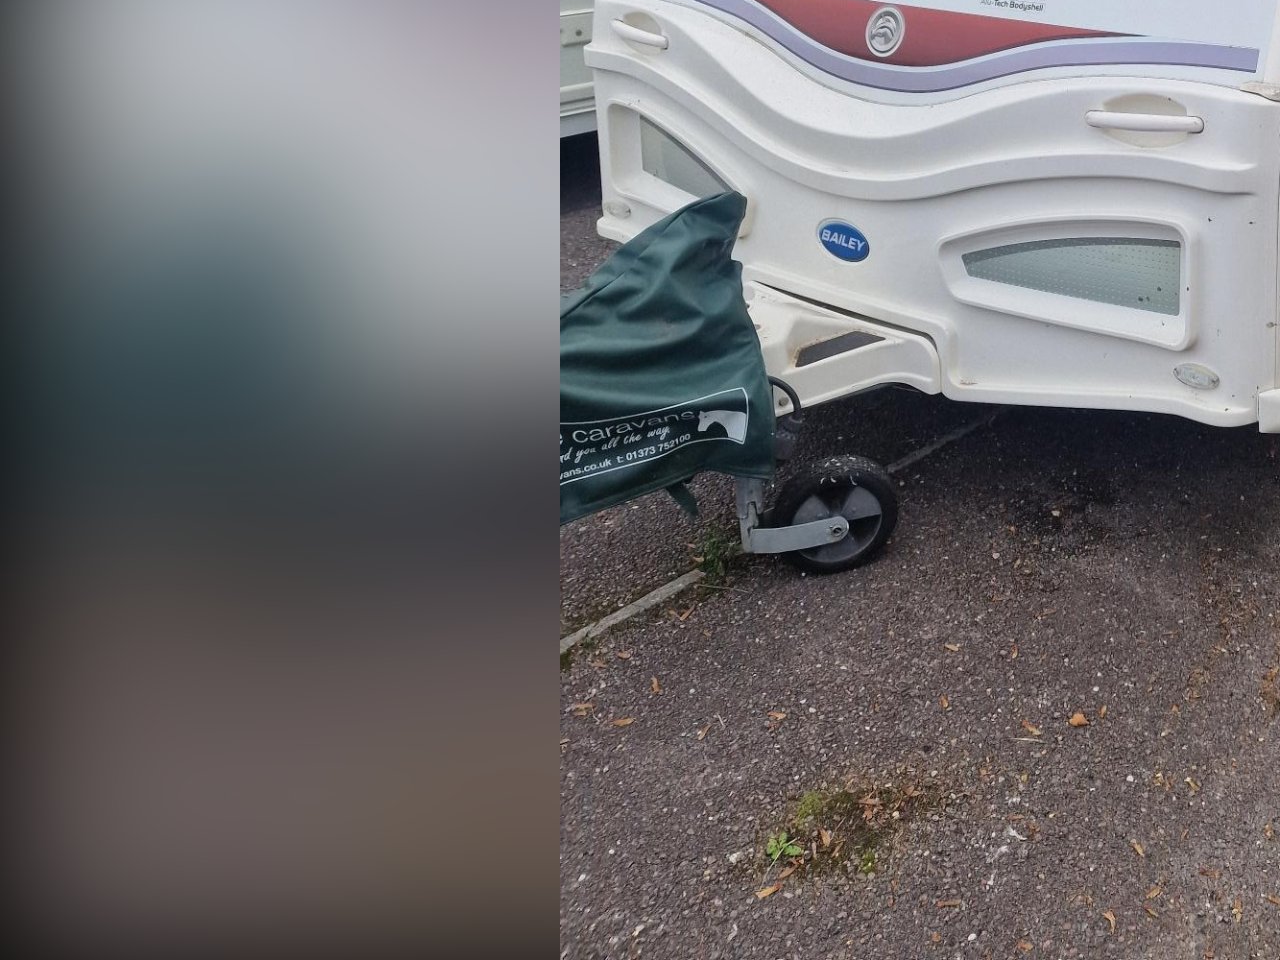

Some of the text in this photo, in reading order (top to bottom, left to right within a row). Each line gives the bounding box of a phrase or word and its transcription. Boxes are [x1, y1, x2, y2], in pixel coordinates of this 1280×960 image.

[1009, 0, 1043, 11] Bodyshell
[822, 228, 866, 252] BAILEY
[574, 447, 597, 464] you
[601, 436, 621, 451] all
[623, 432, 642, 445] the
[626, 445, 656, 460] 01373
[657, 433, 691, 452] 752100
